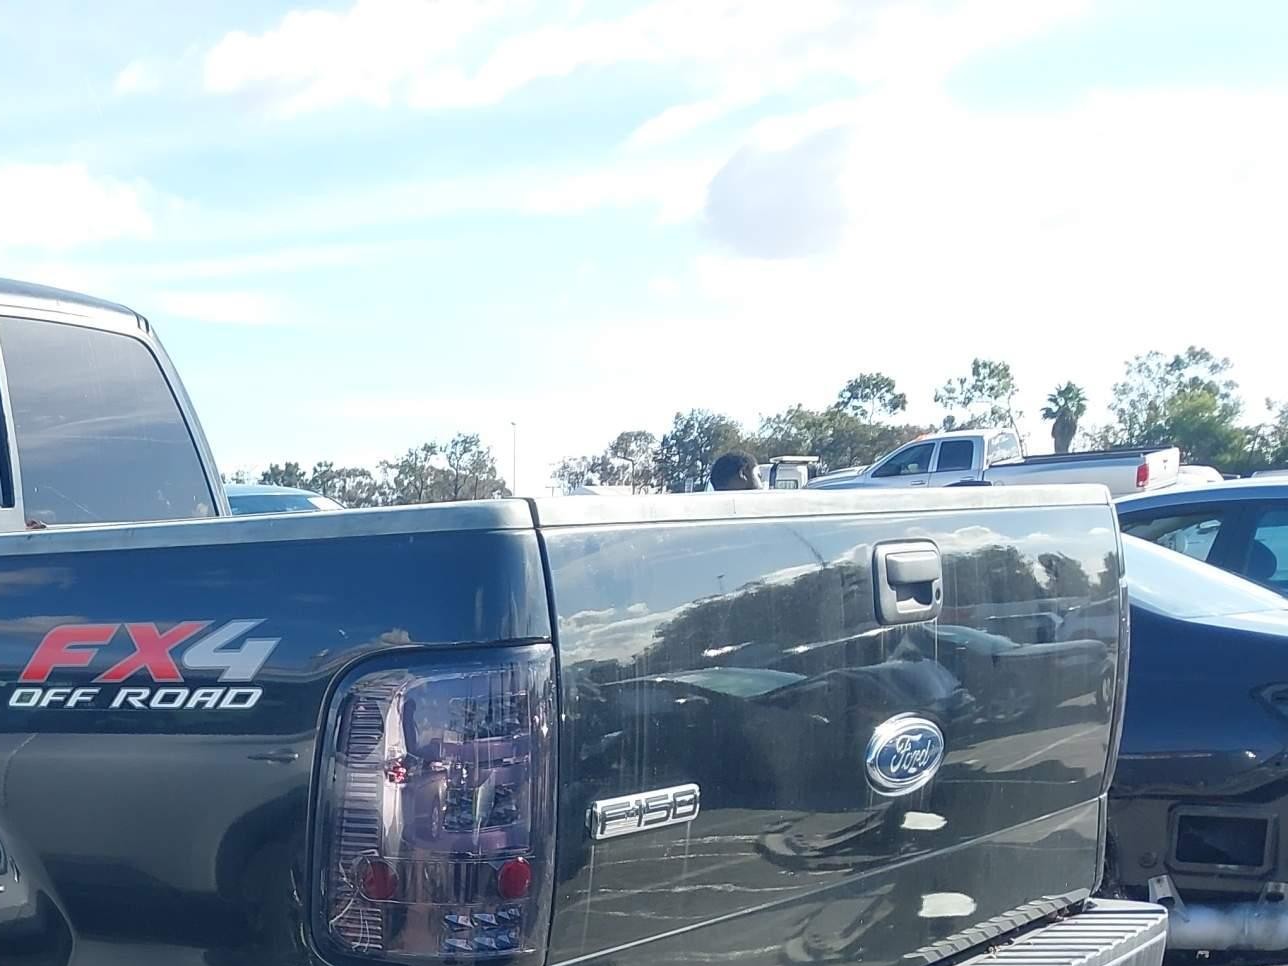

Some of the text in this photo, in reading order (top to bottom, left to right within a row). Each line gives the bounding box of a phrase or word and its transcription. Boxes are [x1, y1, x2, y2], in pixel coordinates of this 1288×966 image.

[18, 618, 281, 683] FX4
[9, 687, 263, 709] OFF ROAD
[889, 733, 932, 774] Ford
[599, 788, 699, 835] F-150
